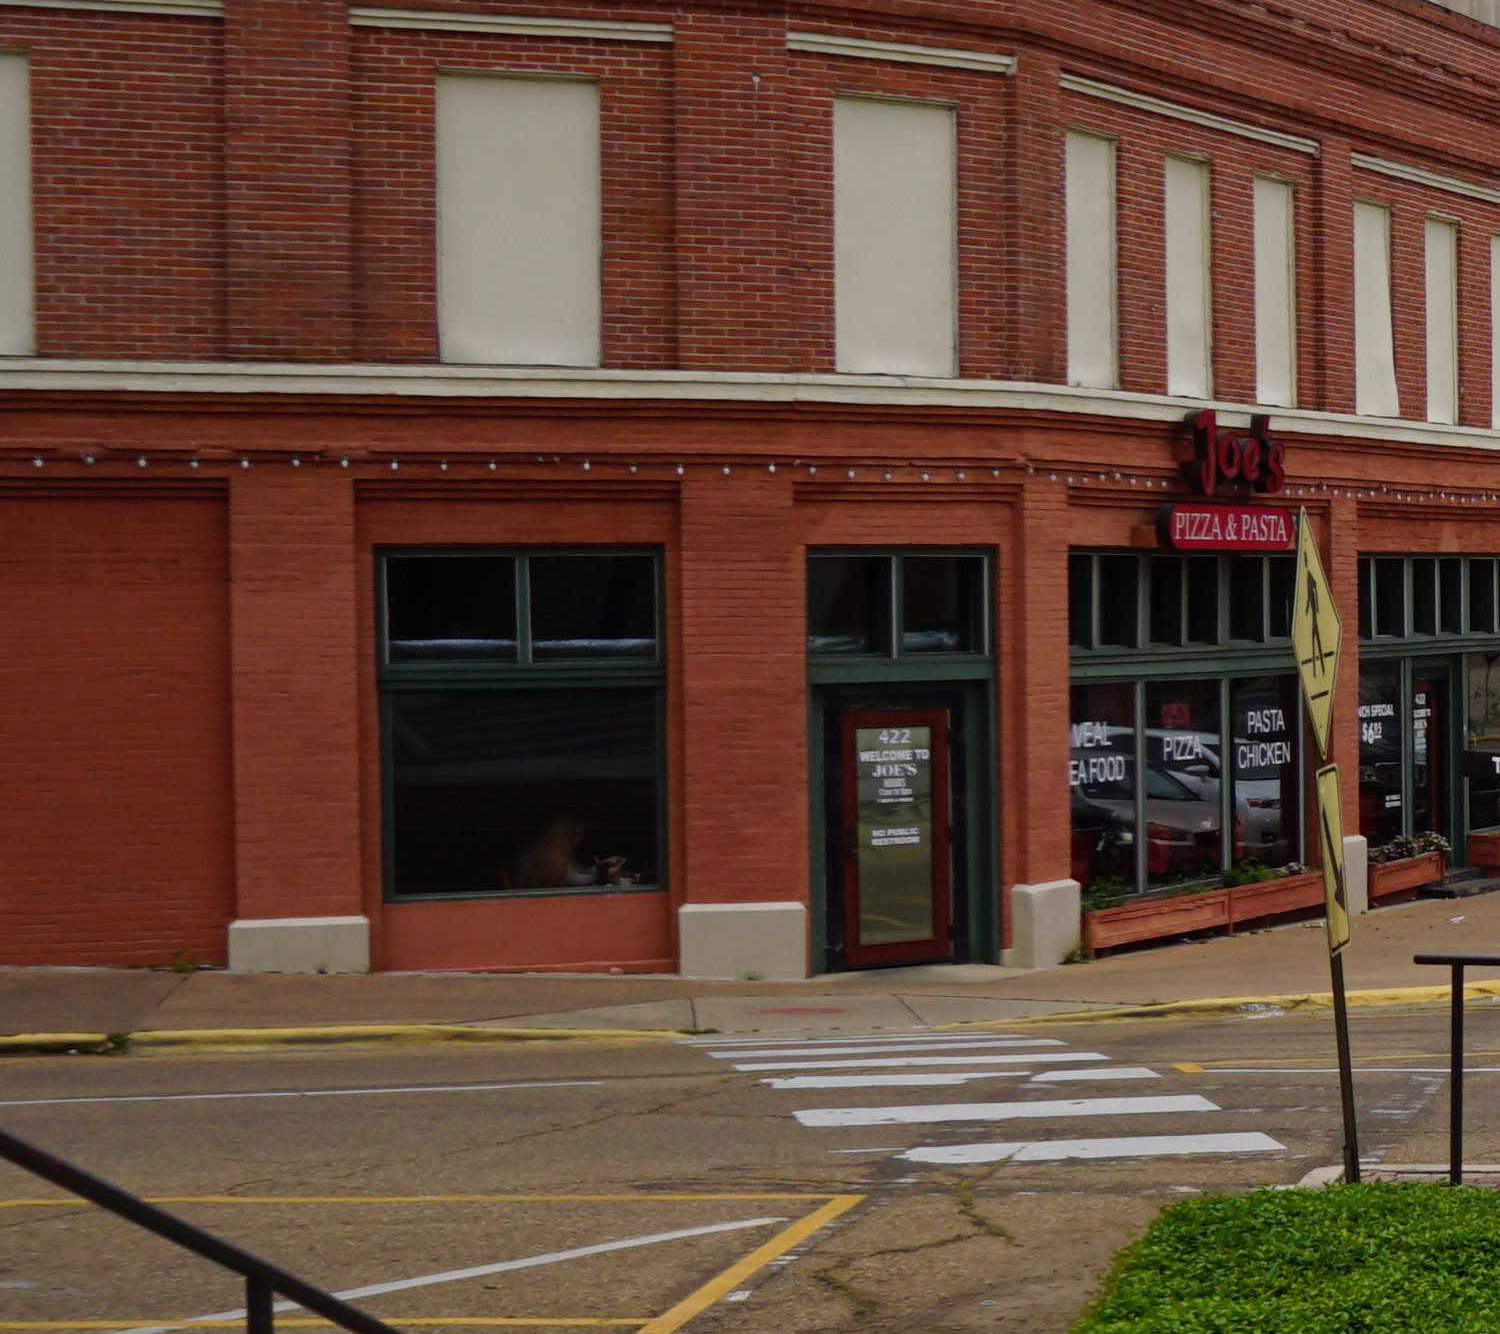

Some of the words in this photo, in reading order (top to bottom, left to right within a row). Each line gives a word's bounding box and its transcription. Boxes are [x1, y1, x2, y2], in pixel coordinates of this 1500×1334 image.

[1194, 409, 1285, 496] Joe's
[1173, 512, 1222, 540] PIZZA
[1225, 513, 1237, 540] &
[1240, 514, 1288, 542] PASTA
[1071, 721, 1112, 748] VEAL
[1247, 709, 1285, 734] PASTA
[878, 729, 911, 744] 422
[1163, 735, 1202, 761] PIZZA
[859, 749, 913, 762] WELCOME
[914, 749, 930, 760] TO
[1238, 741, 1291, 769] CHICKEN
